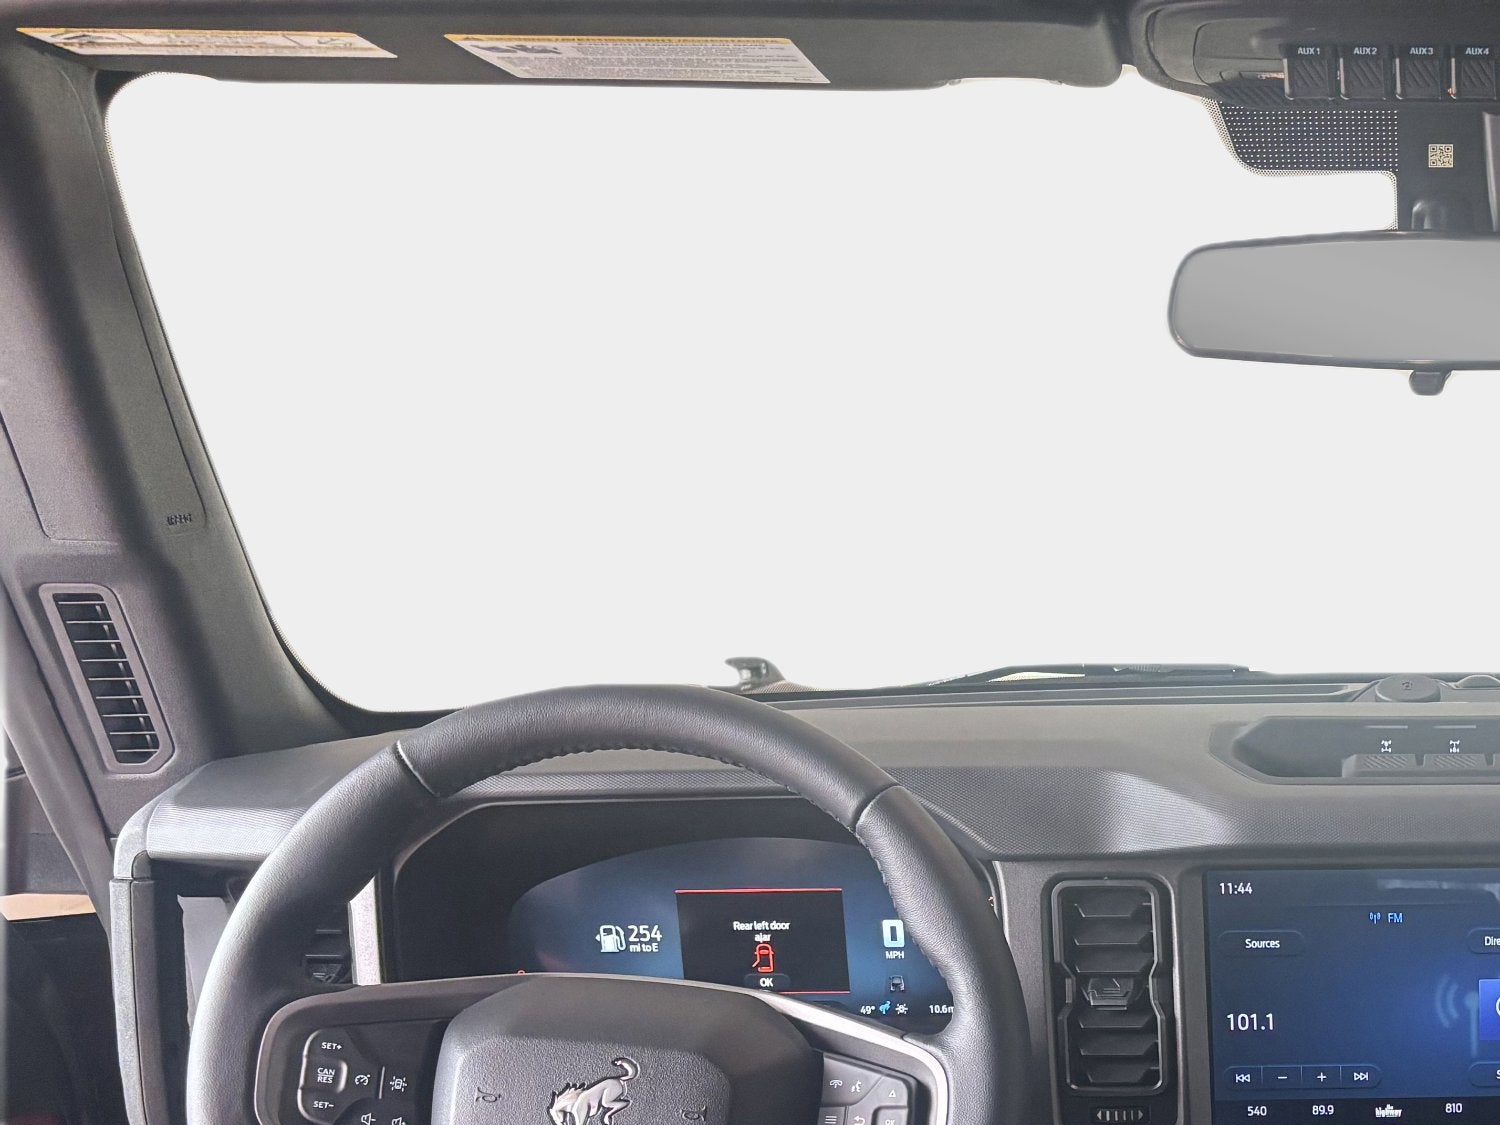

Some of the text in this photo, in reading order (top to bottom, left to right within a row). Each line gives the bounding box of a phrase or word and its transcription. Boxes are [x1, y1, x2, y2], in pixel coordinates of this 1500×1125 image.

[1219, 882, 1253, 895] 11:44
[1388, 912, 1403, 923] FM
[733, 920, 790, 930] Rear left door
[628, 925, 662, 942] 254
[754, 932, 771, 943] ajar
[882, 919, 905, 947] 0
[630, 943, 658, 952] mi to E
[1245, 938, 1280, 949] Sources
[885, 951, 904, 959] MPH
[760, 978, 774, 987] OK
[1226, 1013, 1275, 1032] 101.1
[317, 1067, 336, 1076] CAN
[317, 1076, 333, 1084] RES
[1247, 1105, 1267, 1117] 540
[1312, 1104, 1334, 1116] 89.9
[1375, 1106, 1402, 1118] highway
[1445, 1102, 1463, 1114] 810
